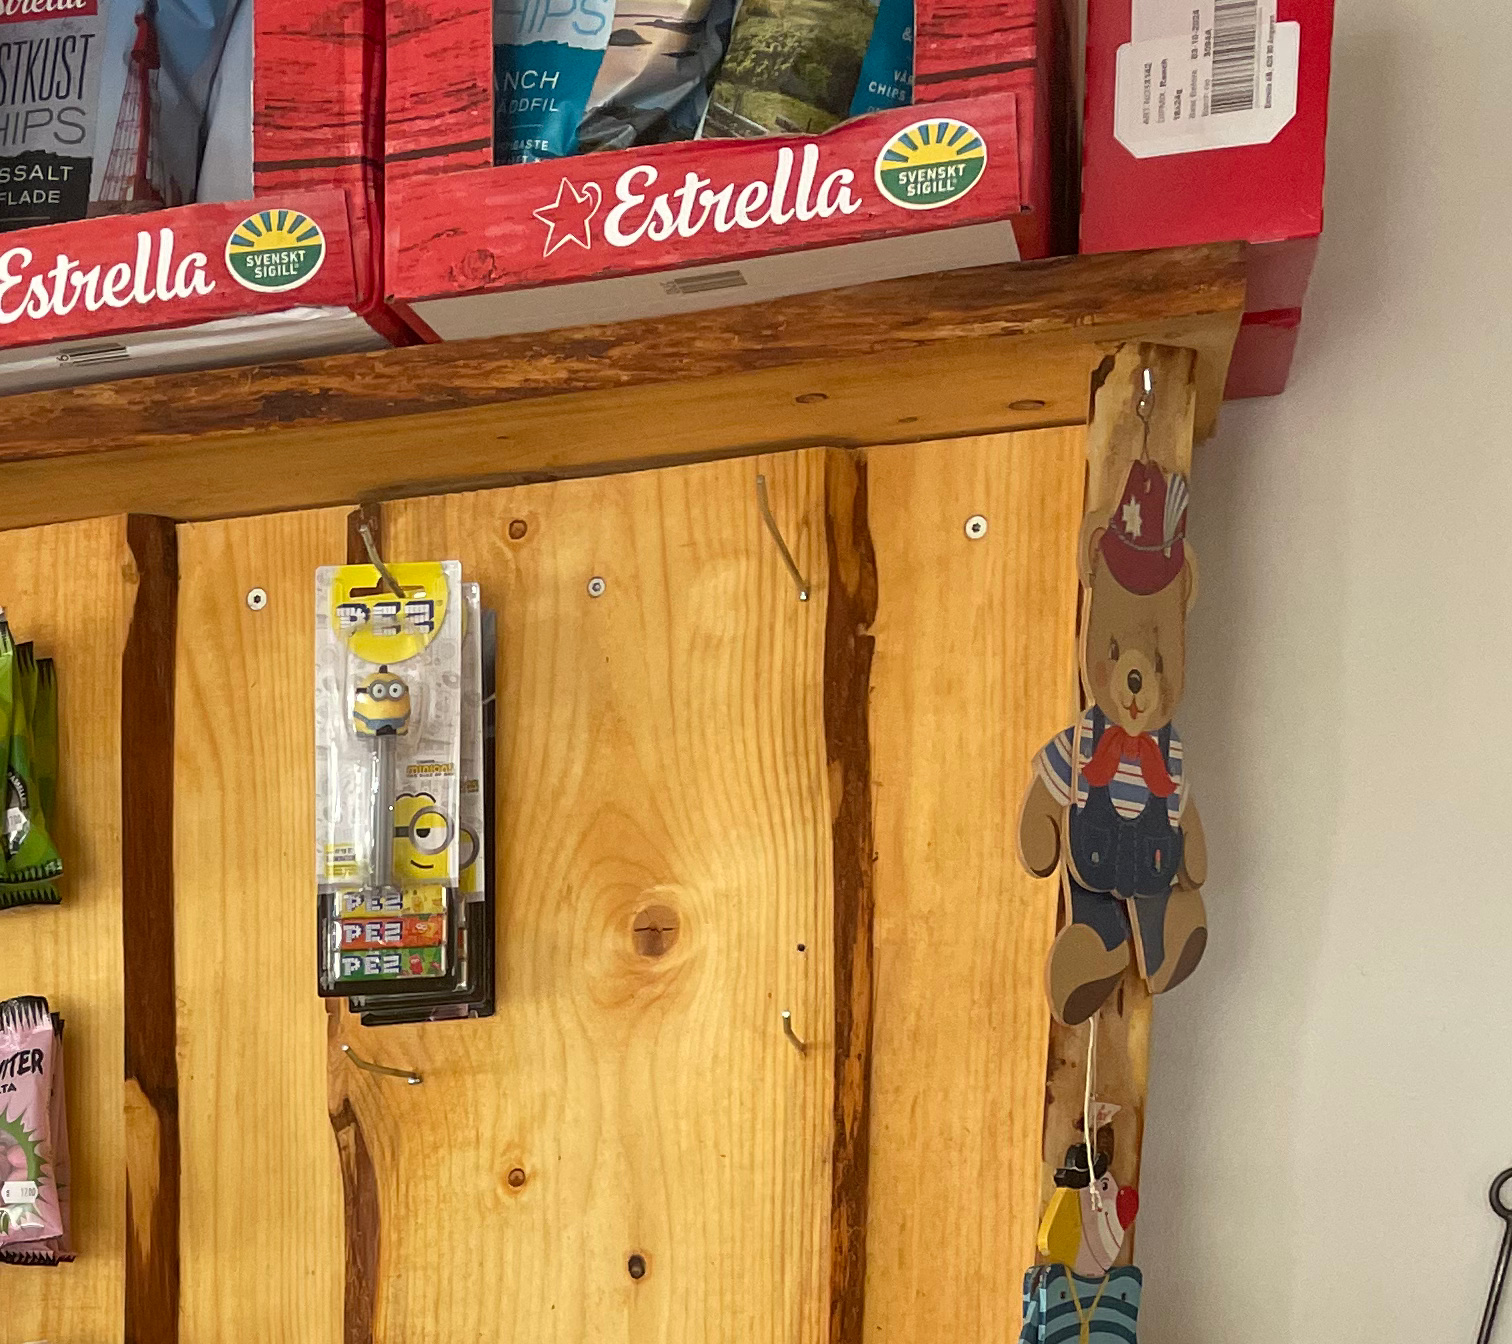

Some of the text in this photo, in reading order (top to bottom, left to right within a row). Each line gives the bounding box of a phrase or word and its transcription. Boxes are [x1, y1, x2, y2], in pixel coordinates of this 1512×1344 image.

[868, 81, 907, 101] CHIPS
[898, 162, 966, 189] SVENSKT
[601, 142, 861, 249] Estrella
[907, 177, 958, 199] SIGILL
[245, 250, 307, 270] SVENSKT
[253, 262, 300, 280] SIGILL
[342, 891, 404, 912] PEZ
[341, 920, 406, 944] PEZ
[341, 953, 403, 977] PEZ
